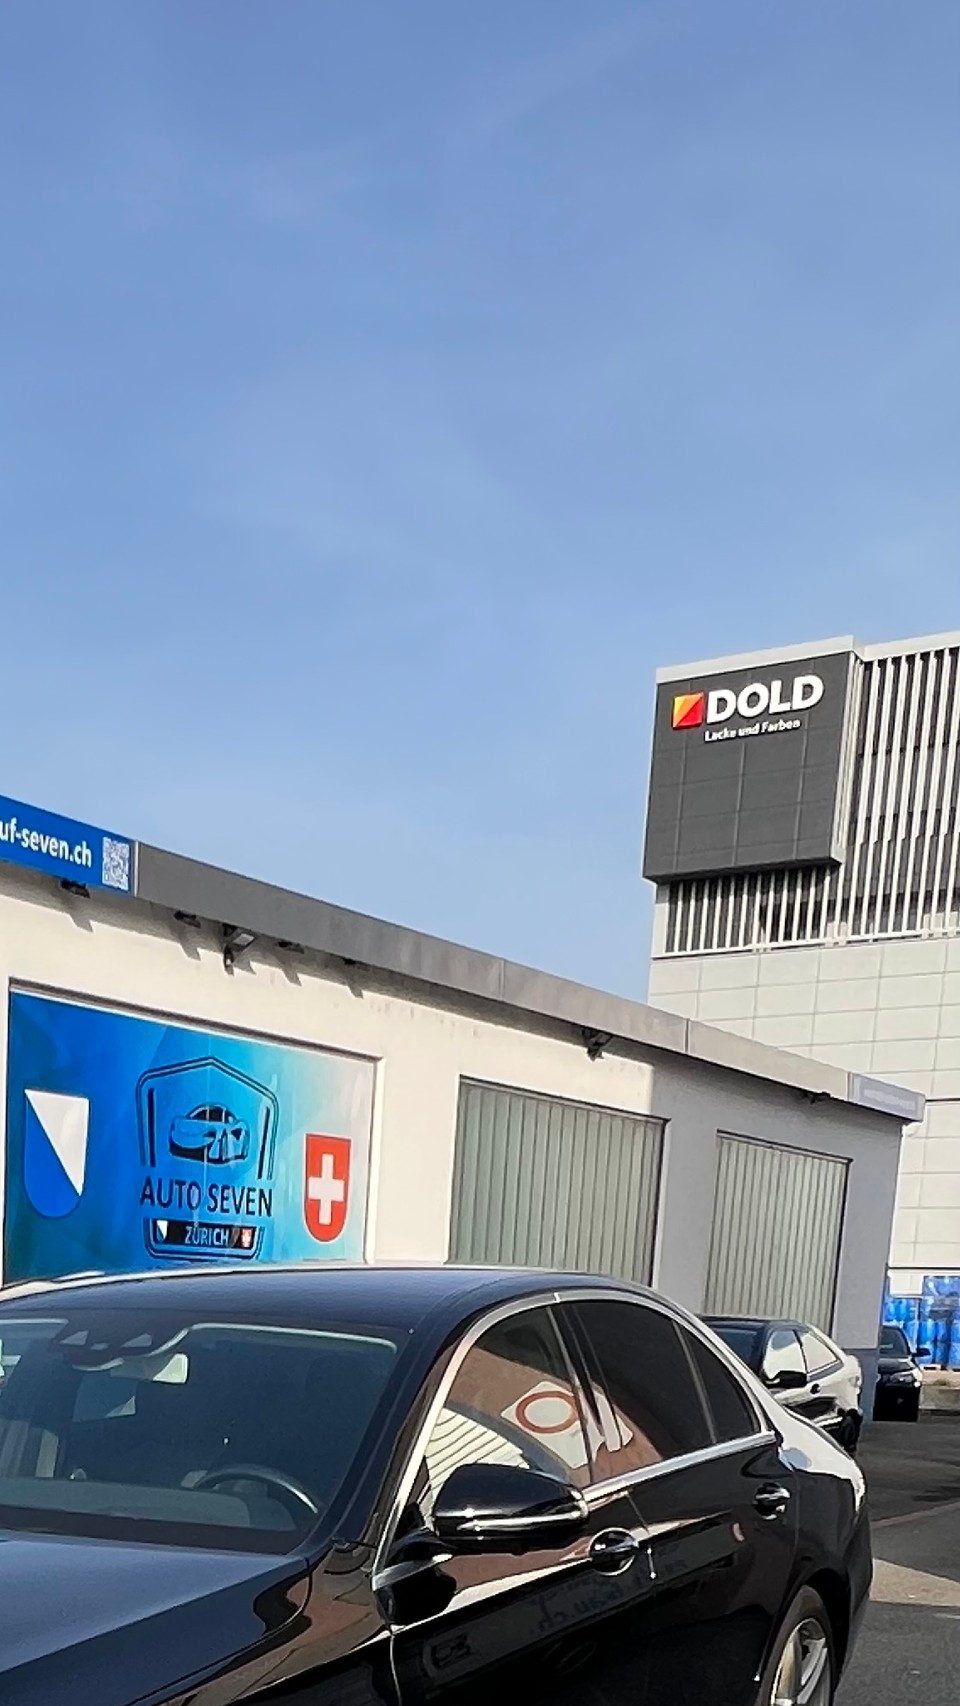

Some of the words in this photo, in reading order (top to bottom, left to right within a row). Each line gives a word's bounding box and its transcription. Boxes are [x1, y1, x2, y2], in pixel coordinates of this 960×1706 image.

[706, 674, 825, 724] DOLD
[704, 727, 737, 742] Lacke
[738, 722, 759, 736] und
[761, 718, 801, 733] Farben
[140, 1175, 201, 1211] AUTO
[206, 1183, 273, 1217] SEVEN
[184, 1224, 230, 1248] ZÜRICH
